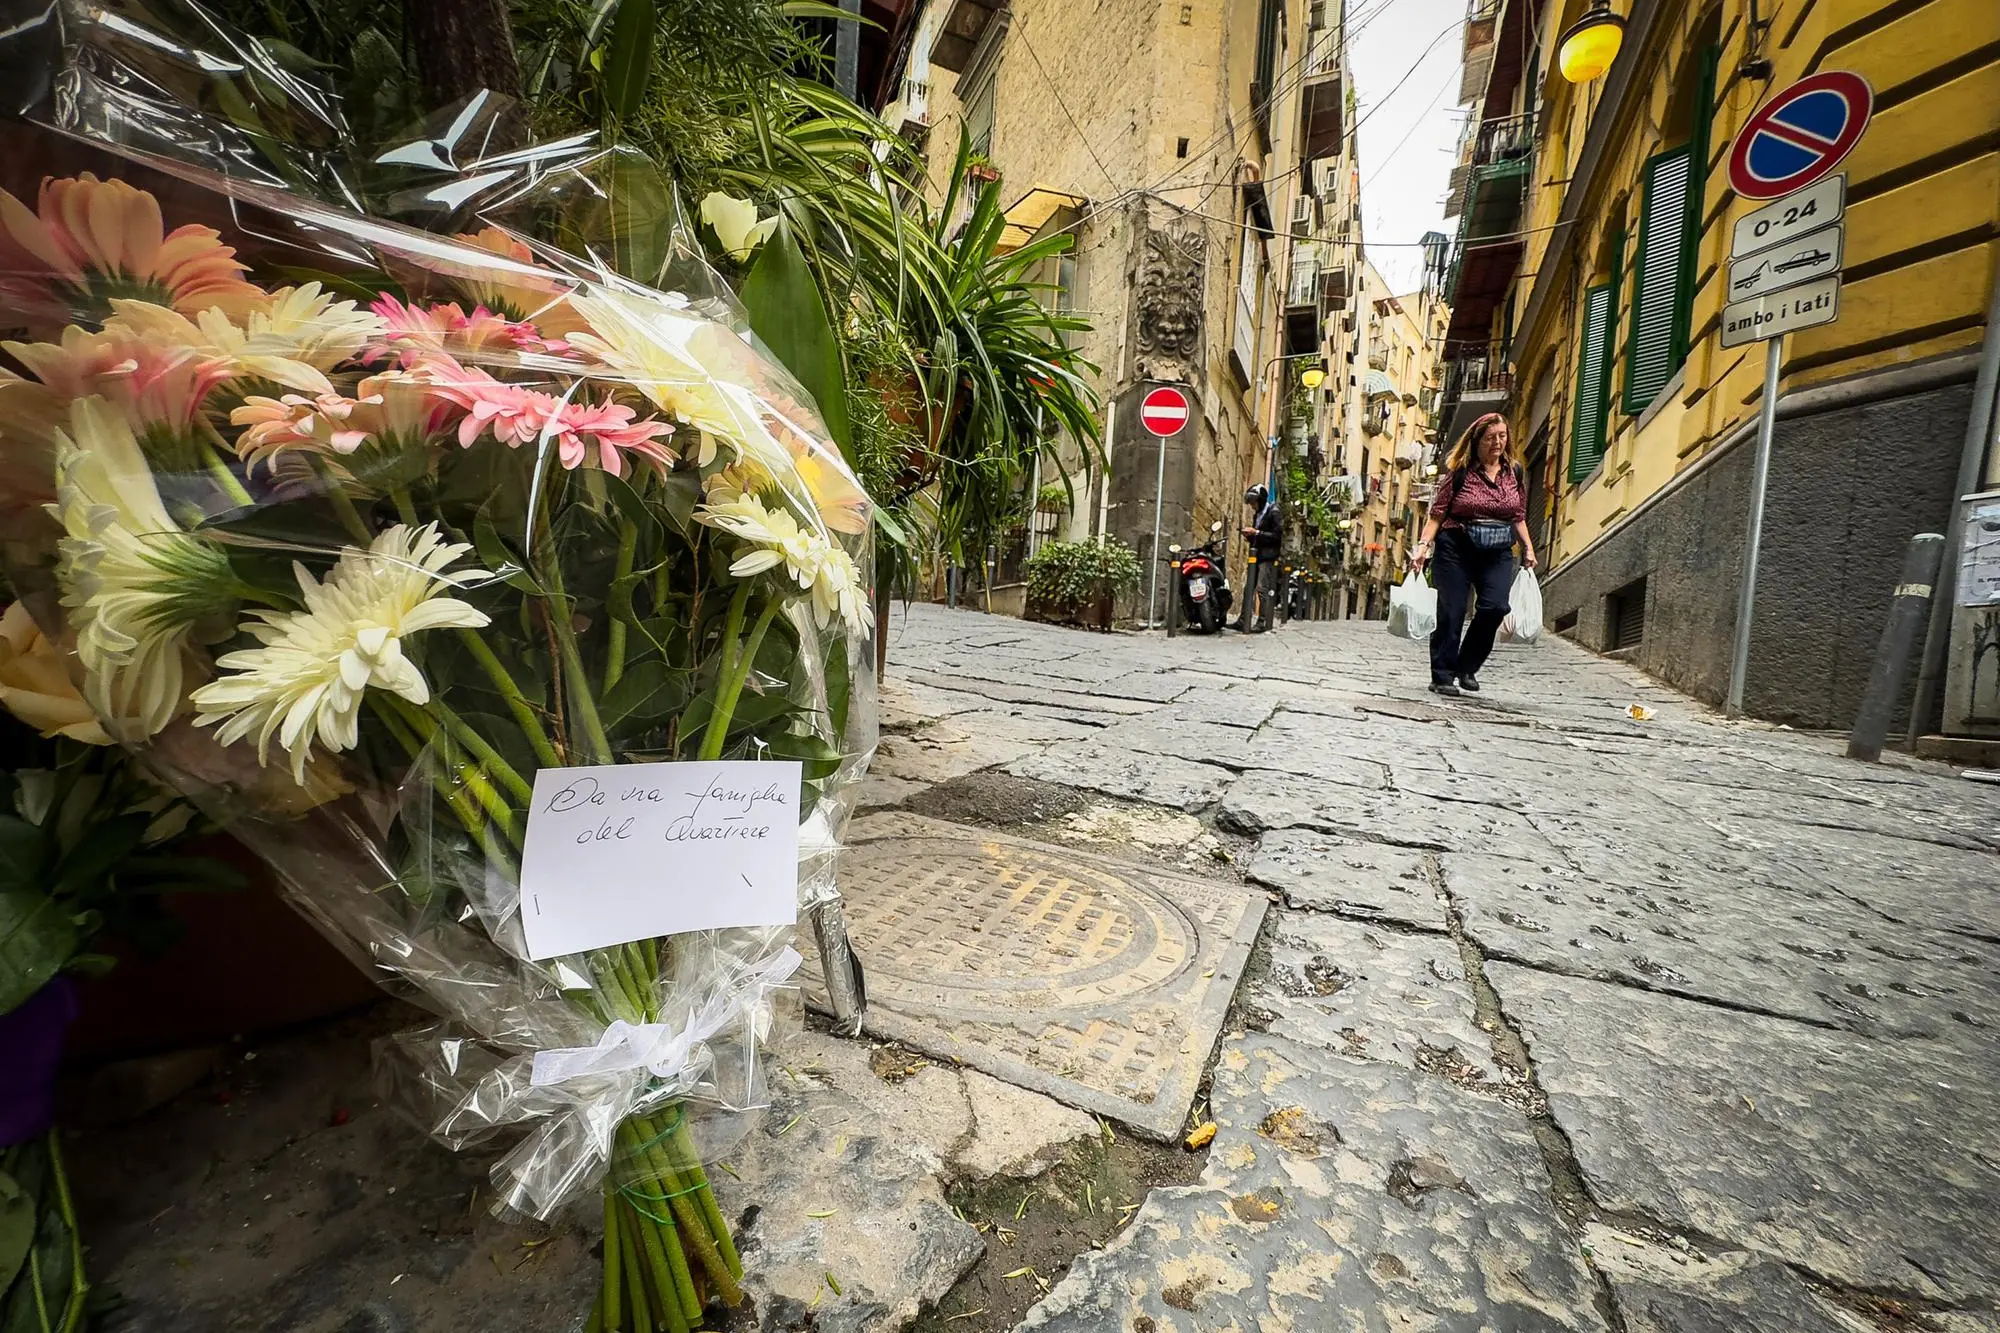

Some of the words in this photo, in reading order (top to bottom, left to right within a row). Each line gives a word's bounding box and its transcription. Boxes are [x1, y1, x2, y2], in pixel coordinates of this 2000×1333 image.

[1753, 198, 1818, 238] 0-24
[1727, 311, 1774, 333] ambo
[1781, 304, 1787, 319] i
[1795, 292, 1831, 315] lati
[543, 776, 605, 814] Da
[576, 816, 636, 844] del
